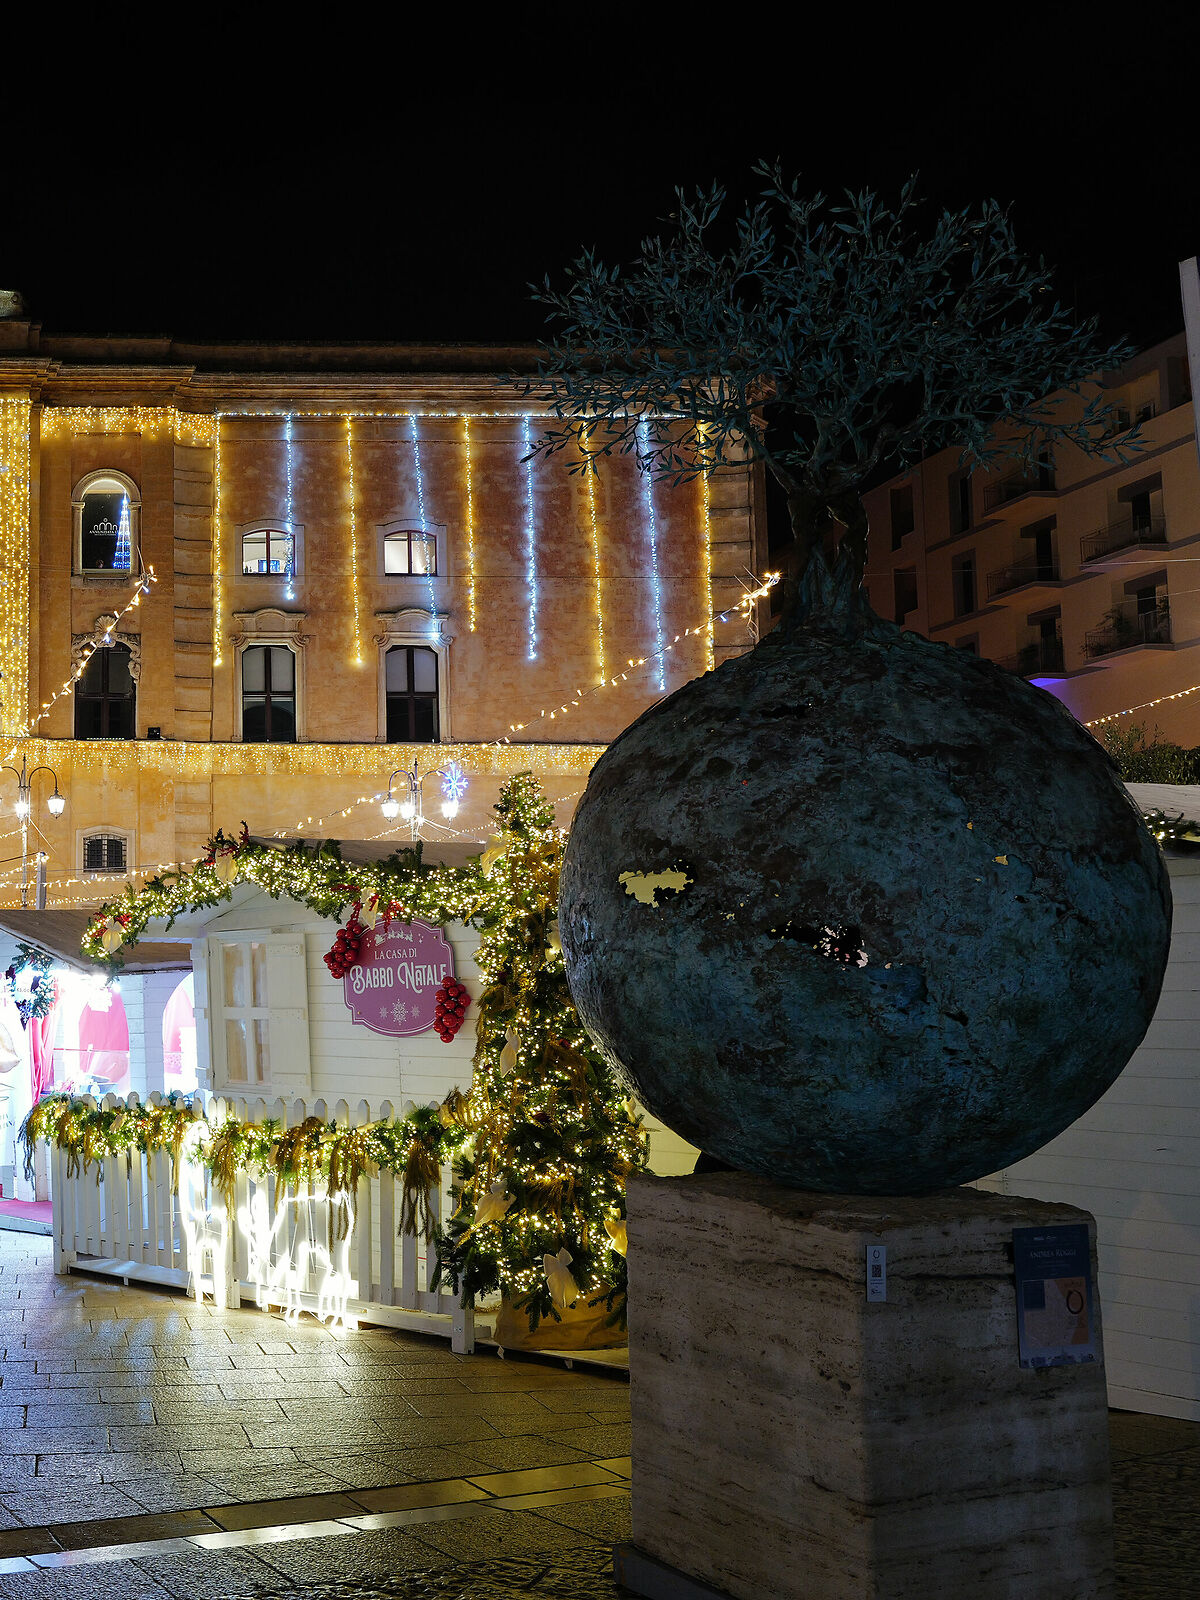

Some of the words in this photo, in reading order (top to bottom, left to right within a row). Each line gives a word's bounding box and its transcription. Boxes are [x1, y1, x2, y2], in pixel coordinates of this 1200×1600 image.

[374, 950, 385, 960] LA
[385, 948, 408, 960] CASA
[408, 947, 418, 958] DI
[349, 964, 394, 995] BABBO
[397, 961, 447, 993] NATALE
